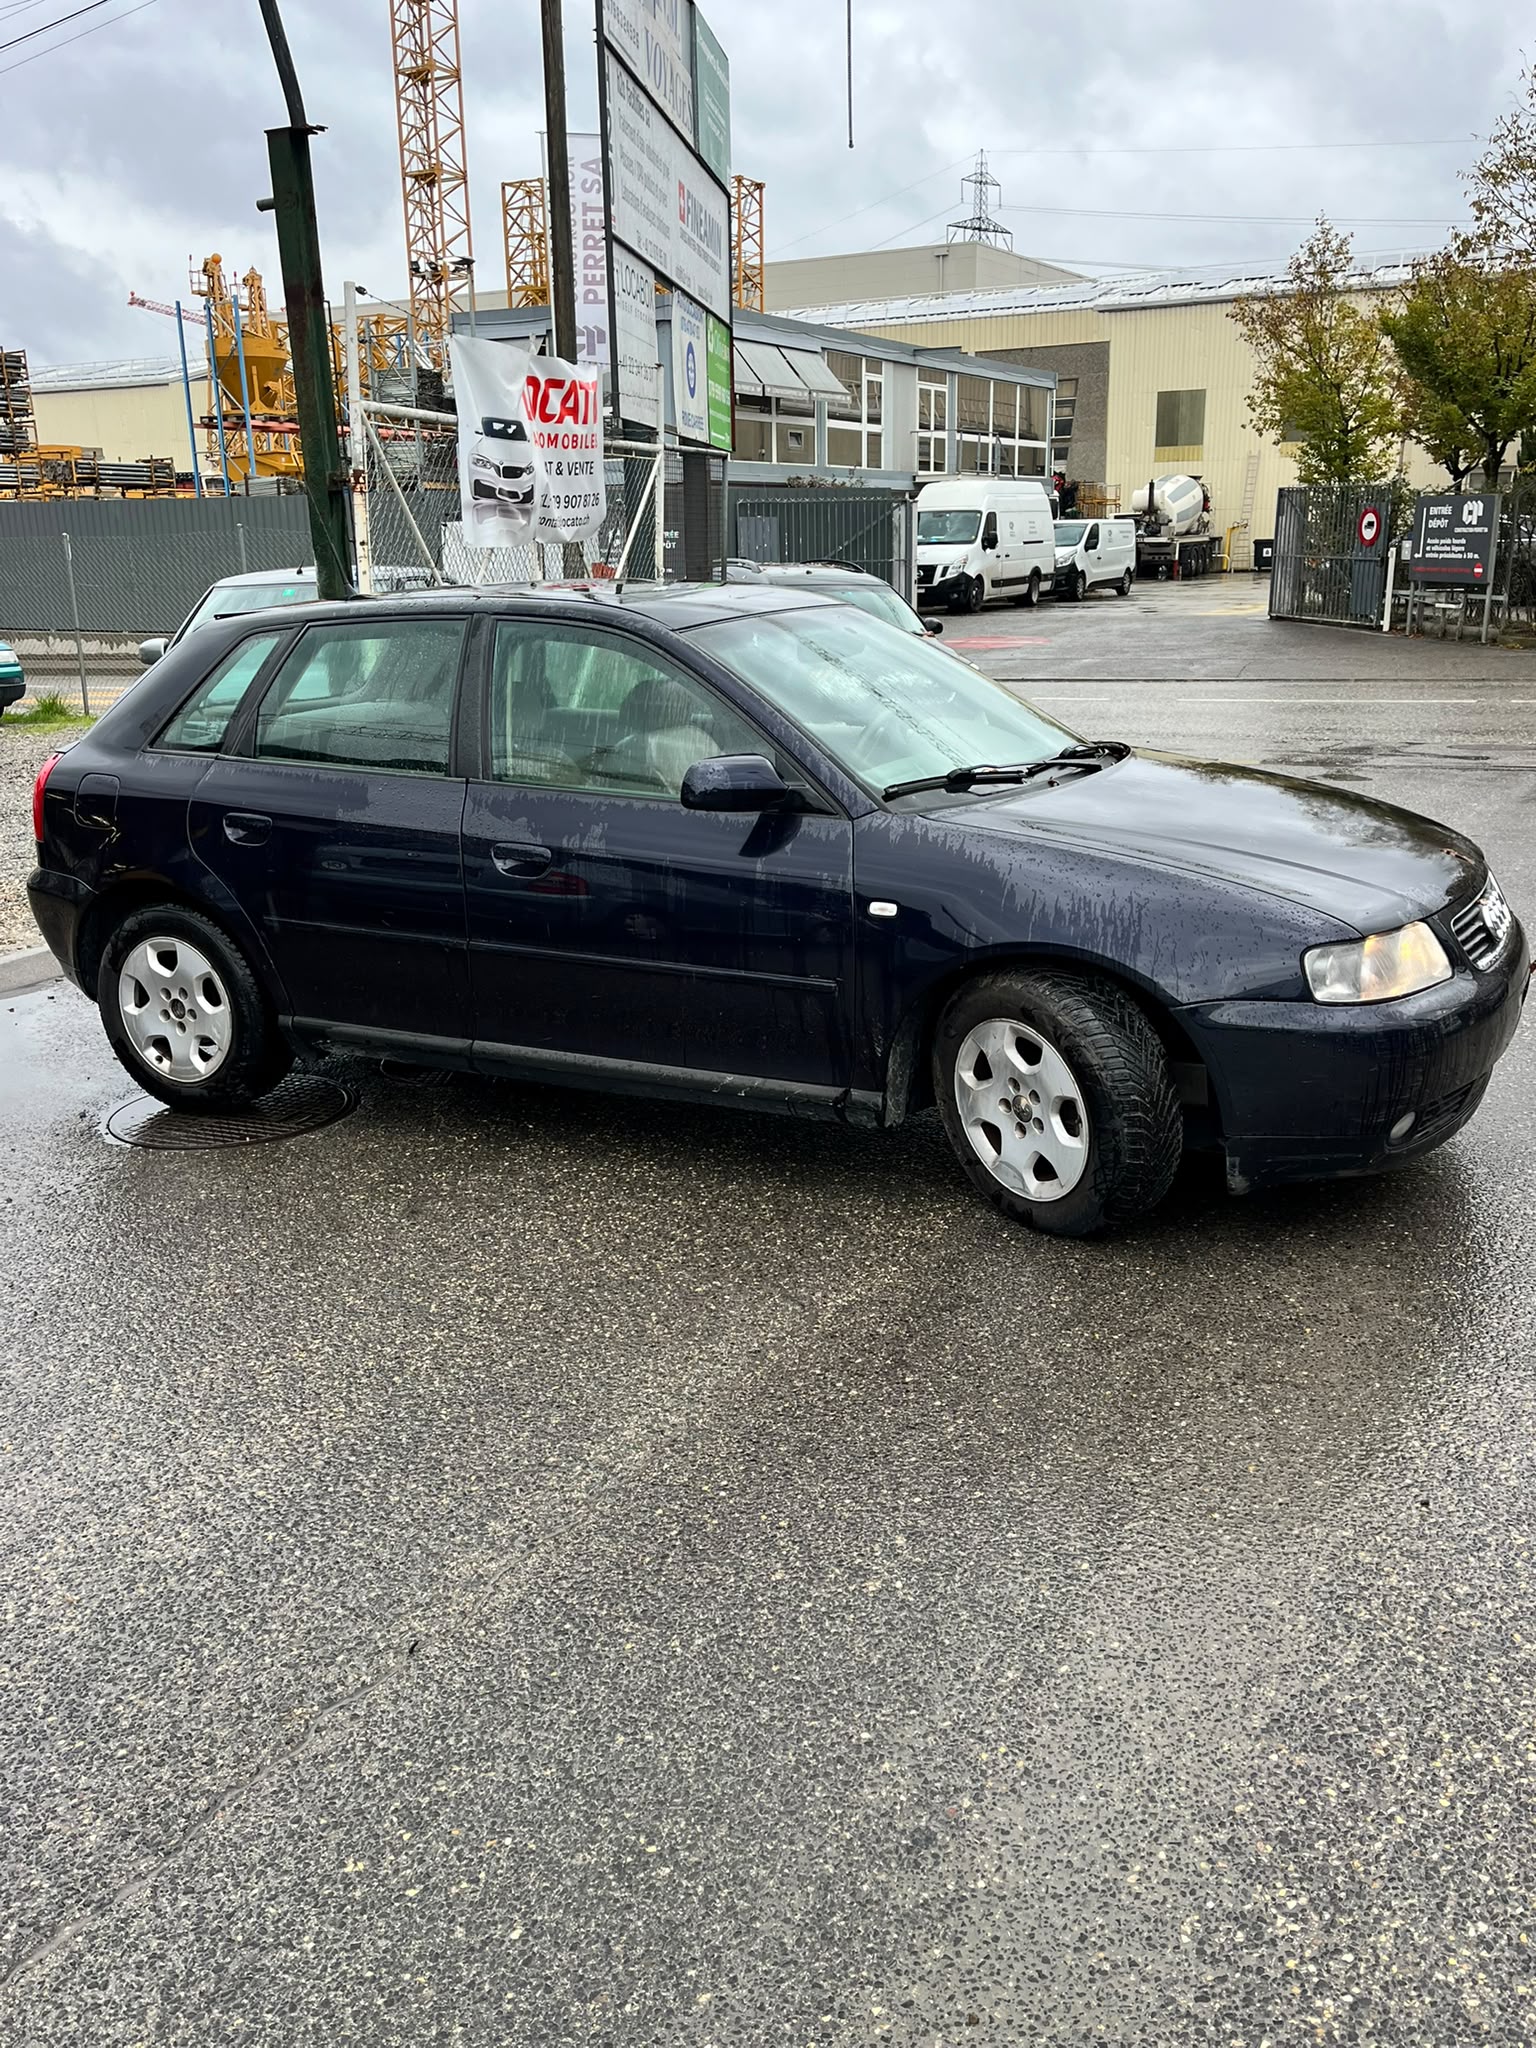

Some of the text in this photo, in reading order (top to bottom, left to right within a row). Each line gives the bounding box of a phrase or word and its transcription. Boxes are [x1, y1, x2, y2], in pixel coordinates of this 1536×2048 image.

[644, 26, 693, 135] VOYAGES
[580, 157, 606, 305] PERRET SA
[555, 461, 564, 476] &
[567, 460, 594, 476] VENTE
[563, 494, 582, 509] 907
[1429, 504, 1453, 515] ENTRÉE
[1428, 517, 1449, 528] DÉPÔT
